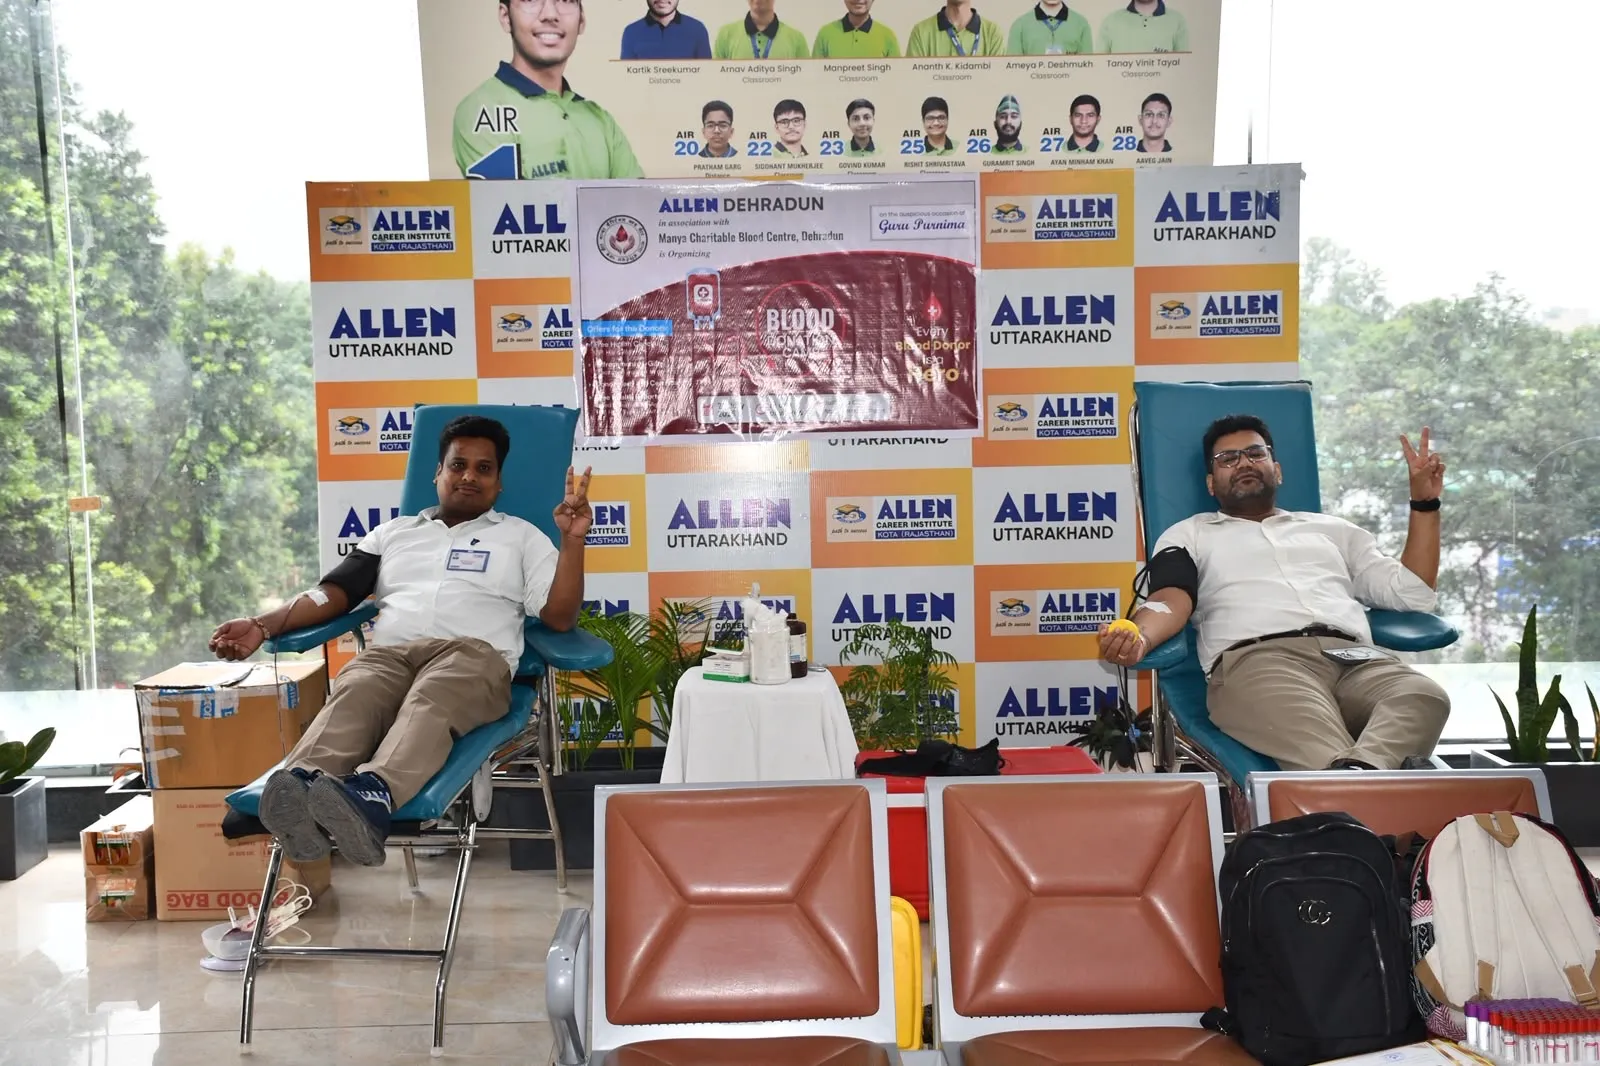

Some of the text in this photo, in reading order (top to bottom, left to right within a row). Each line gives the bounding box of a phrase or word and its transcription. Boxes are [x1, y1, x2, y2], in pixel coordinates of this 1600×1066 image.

[626, 66, 700, 74] Kartik Sreekumar
[748, 64, 776, 74] Aditya
[777, 64, 802, 74] Singh
[824, 64, 891, 73] Manpreet Singh
[955, 62, 991, 70] Kidambi
[1006, 62, 1037, 70] Ameya
[1048, 60, 1093, 69] Deshmukh
[1107, 60, 1133, 68] Tanay
[1156, 58, 1180, 67] Tayal
[742, 76, 782, 84] Classroom
[1030, 72, 1070, 80] Classroom
[1122, 70, 1161, 78] Classroom
[474, 106, 519, 132] AIR
[676, 131, 694, 139] AIR
[822, 130, 840, 138] AIR
[1115, 126, 1133, 134] AIR
[674, 141, 699, 156] 20
[747, 142, 772, 156] 22
[820, 140, 844, 155] 23
[900, 140, 925, 154] 25
[966, 138, 991, 153] 26
[1040, 137, 1064, 152] 27
[1112, 136, 1137, 150] 28
[532, 160, 568, 178] ALLEN
[787, 162, 823, 170] MUKHERJEE
[658, 197, 824, 213] ALLEN DEHRADUN
[1037, 198, 1113, 219] ALLEN
[1154, 190, 1280, 223] ALLEN
[373, 210, 450, 231] ALLEN
[878, 219, 965, 234] Guru Purnima
[407, 232, 451, 240] INSTITUTE
[659, 231, 844, 244] Manya Charitable Blood Centre, Dehradun
[1060, 230, 1115, 238] (RAJASTHAN)
[1154, 225, 1276, 242] UTTARAKHAND
[373, 242, 452, 251] KOTA (RAJASTHAN)
[492, 239, 570, 254] UTTARAK
[659, 250, 711, 259] is Organizing
[991, 295, 1115, 326] ALLEN
[1202, 295, 1278, 316] ALLEN
[330, 307, 456, 339] ALLEN
[766, 308, 834, 331] BLOOD
[917, 327, 948, 340] Every
[990, 329, 1111, 345] UTTARAKHAND
[1225, 326, 1280, 335] (RAJASTHAN)
[768, 335, 834, 346] DONATION
[933, 341, 970, 350] Donor
[329, 342, 453, 358] UTTARAKHAND
[1038, 397, 1114, 418] ALLEN
[1062, 428, 1116, 436] (RAJASTHAN)
[828, 438, 948, 446] UTTARAKHAND
[668, 498, 791, 530] ALLEN
[877, 498, 952, 520] ALLEN
[994, 492, 1117, 523] ALLEN
[667, 532, 788, 548] UTTARAKHAND
[901, 529, 954, 538] (RAJASTHAN)
[993, 526, 1114, 541] UTTARAKHAND
[832, 592, 955, 623] ALLEN
[1041, 593, 1116, 613] ALLEN
[996, 686, 1118, 717] ALLEN
[166, 892, 290, 908] BOOD BAG
